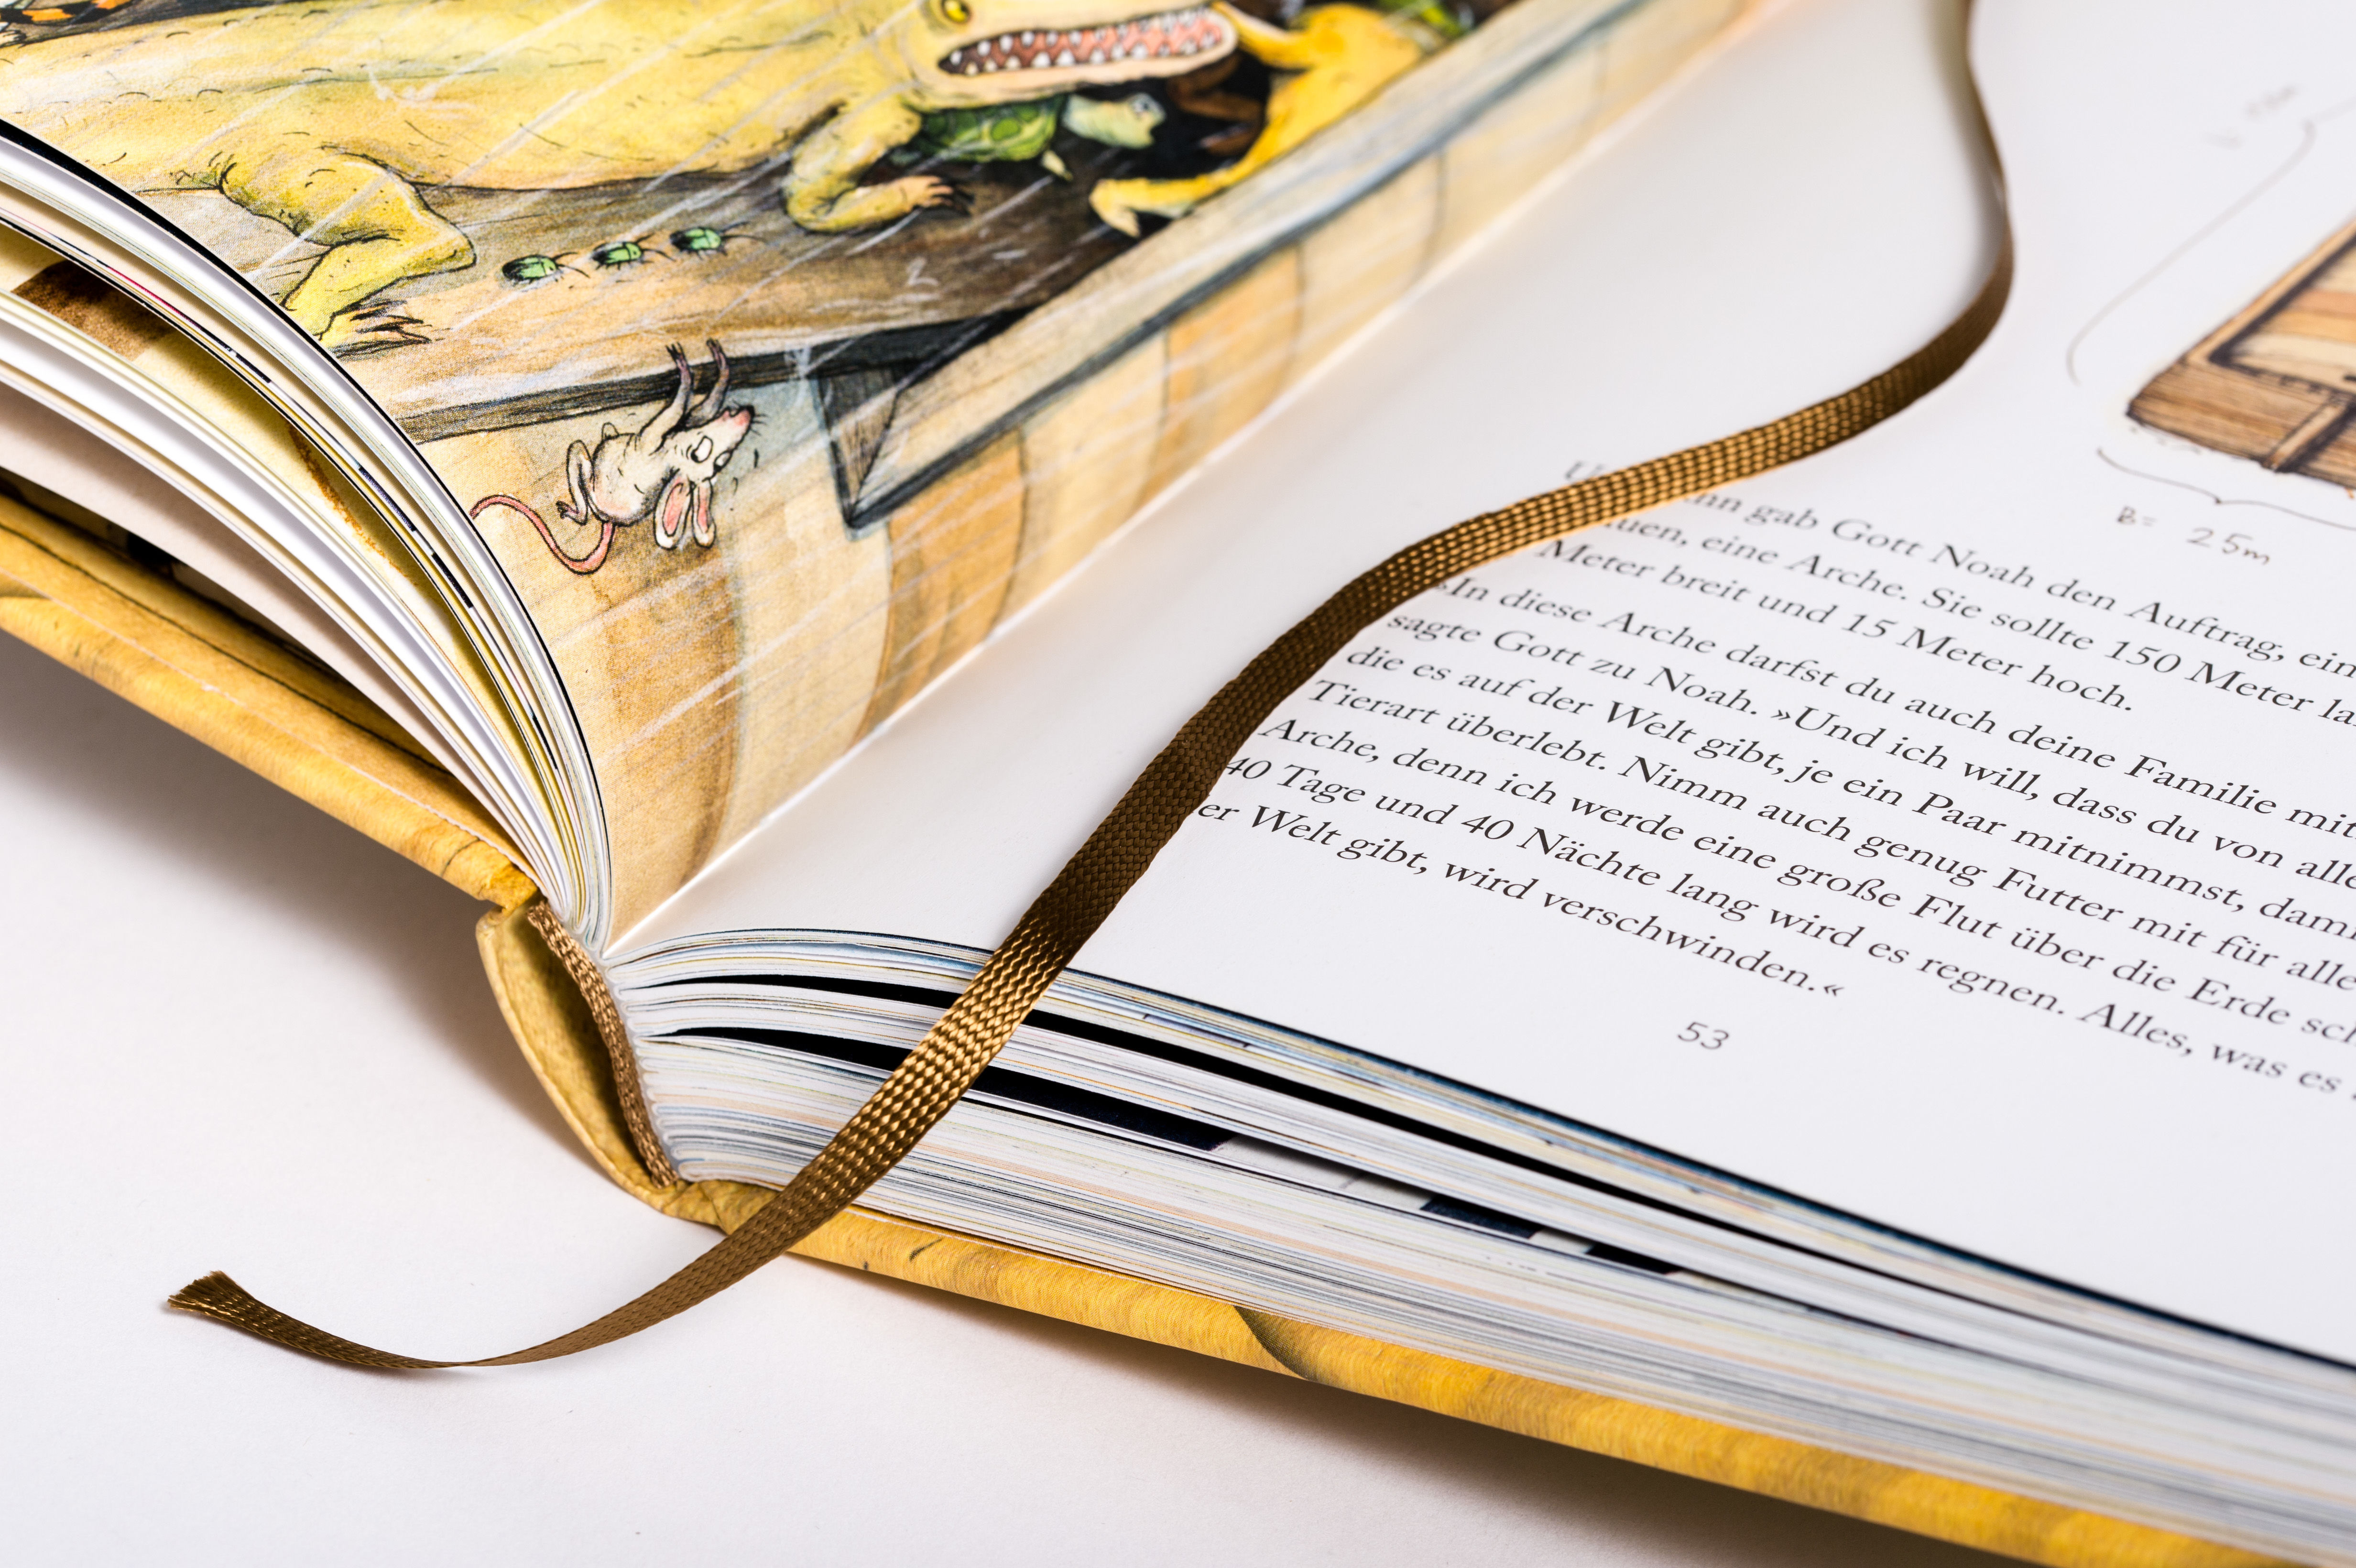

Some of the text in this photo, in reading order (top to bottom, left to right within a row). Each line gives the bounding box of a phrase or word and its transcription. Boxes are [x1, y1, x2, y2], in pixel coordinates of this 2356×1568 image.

[1499, 588, 1592, 622] diese
[1598, 612, 1716, 653] Arche
[1725, 644, 1839, 686] darfst
[1845, 677, 1896, 704] du
[1904, 699, 1996, 734] auch
[2008, 725, 2115, 767] deine
[2124, 755, 2276, 814] Familie
[2285, 809, 2356, 839] mit
[1537, 540, 2131, 711] Meter breit und 15 Meter hoch.
[1701, 536, 1778, 563] eine
[1787, 555, 1906, 600] Arche.
[1921, 588, 1982, 618] Sie
[1991, 614, 2094, 650] sollte
[2105, 642, 2181, 673] 150
[2184, 661, 2314, 711] Meter
[2318, 699, 2356, 727] la
[1745, 507, 1818, 528] gab
[1832, 520, 1921, 556] Gott
[1931, 544, 2034, 588] Noah
[2046, 579, 2116, 611] den
[2125, 602, 2284, 662] Auftrag,
[2299, 653, 2356, 678] ein
[1256, 719, 1379, 762] Arche,
[1393, 748, 1487, 785] denn
[1494, 773, 1556, 805] ich
[1571, 797, 1684, 840] werde
[1694, 836, 1776, 868] eine
[1777, 865, 1901, 907] große
[1909, 894, 2002, 938] Flut
[2011, 927, 2105, 969] über
[2112, 959, 2176, 991] die
[2186, 977, 2291, 1024] Erde
[1309, 679, 2356, 991] Tierart überlebt. Nimm auch genug Futter mit für alle
[1346, 646, 1404, 671] die
[1413, 664, 1451, 680] es
[1458, 675, 1536, 697] auf
[1528, 686, 1594, 715] der
[1607, 700, 1697, 743] Welt
[1693, 739, 1784, 775] gibt,
[1784, 760, 1833, 783] je
[1843, 779, 1902, 806] ein
[1911, 792, 2007, 835] Paar
[2011, 830, 2244, 912] mitnimmst,
[1387, 616, 2356, 889] sagte Gott zu Noah. »Und ich will, dass du von alle
[1193, 803, 1844, 997] er Welt gibt, wird verschwinden.«
[1227, 757, 2341, 1092] 40 Tage und 40 Nächte lang wird es regnen. Alles, was es
[1677, 1021, 1730, 1050] 53
